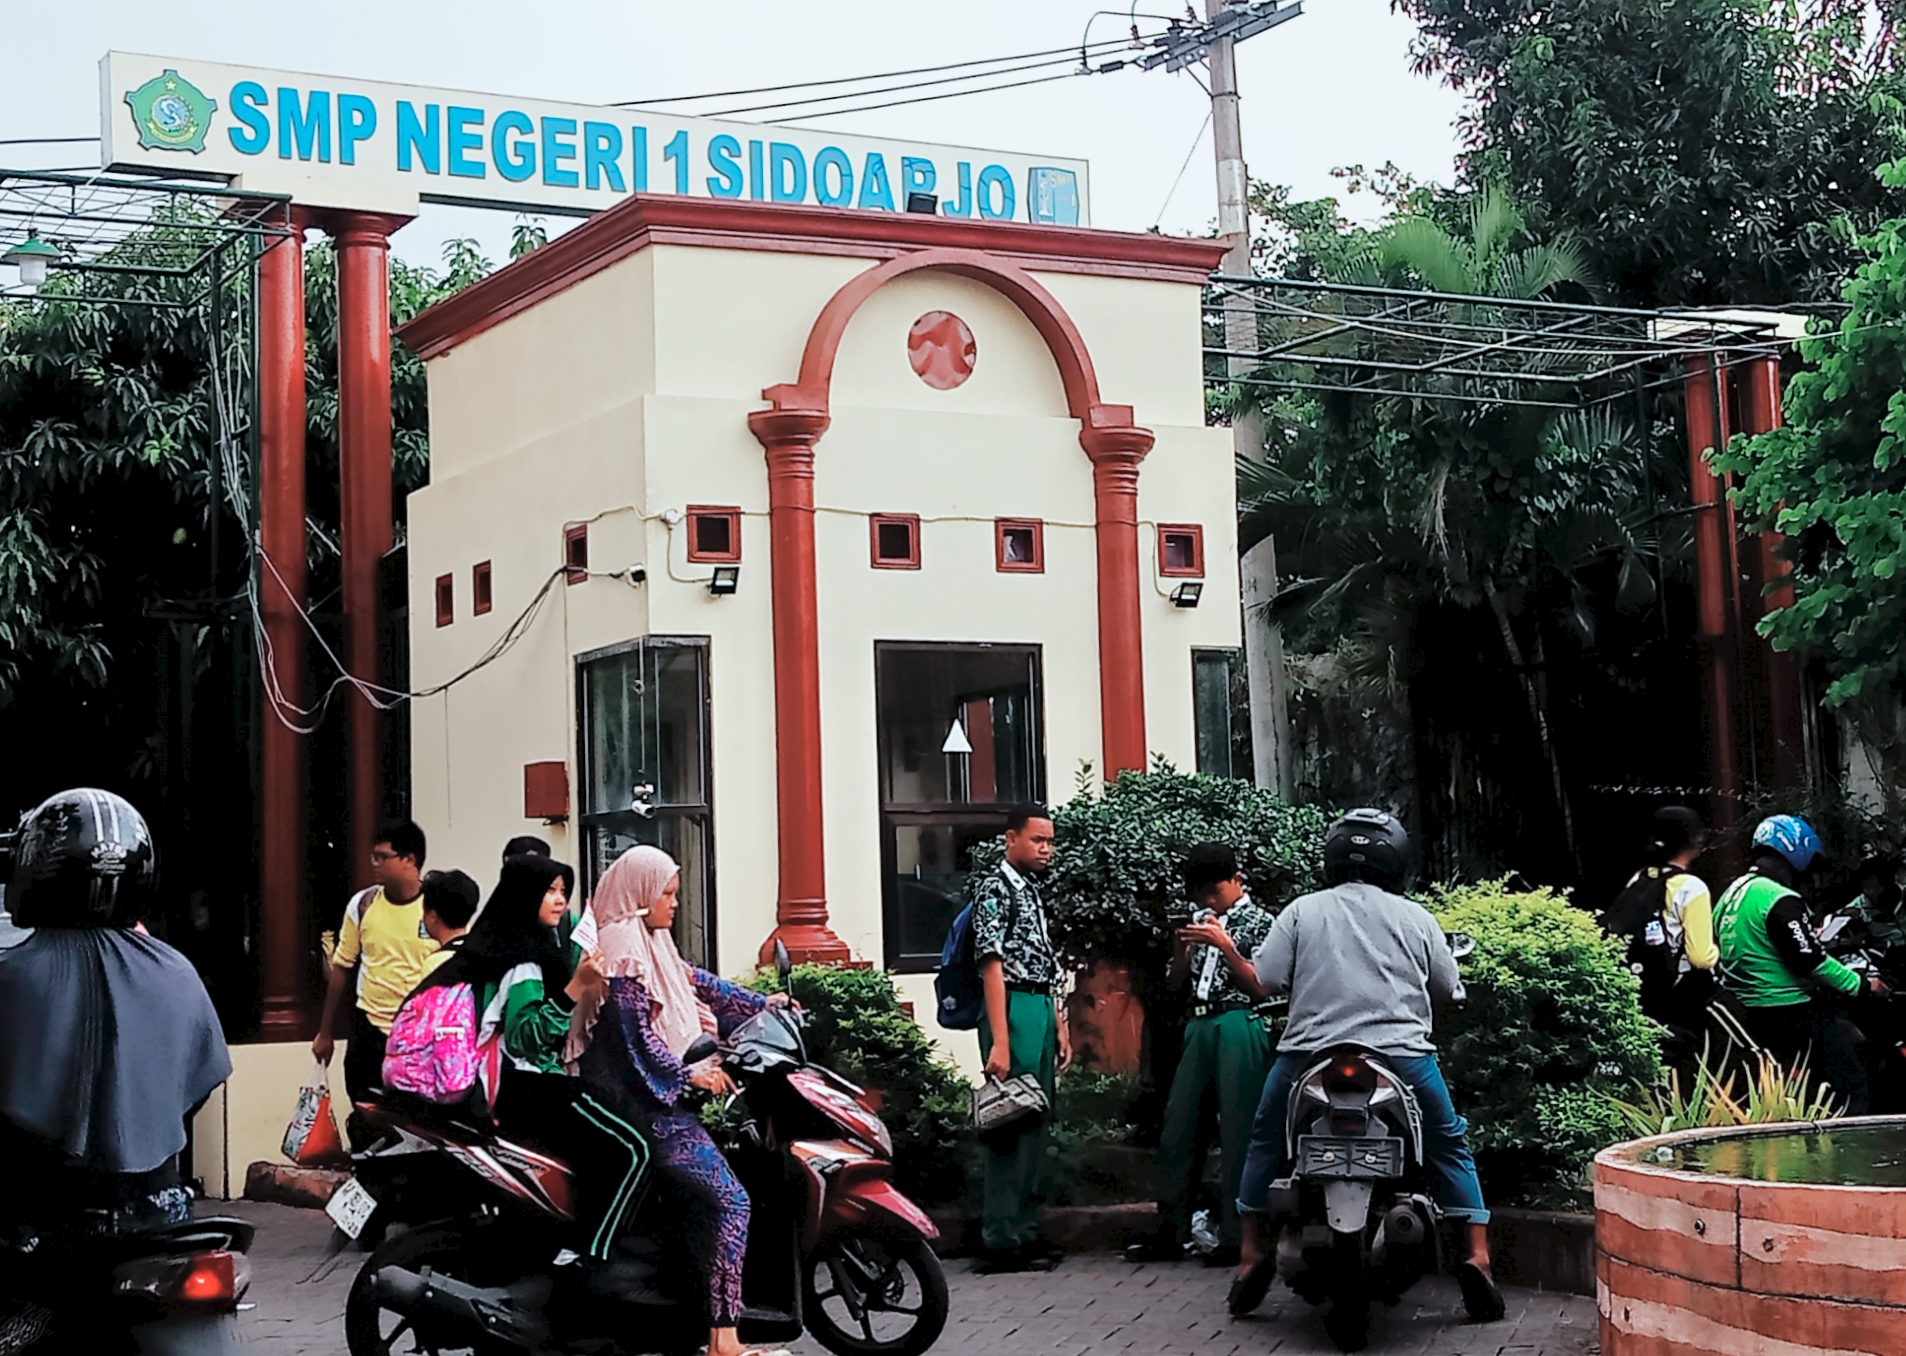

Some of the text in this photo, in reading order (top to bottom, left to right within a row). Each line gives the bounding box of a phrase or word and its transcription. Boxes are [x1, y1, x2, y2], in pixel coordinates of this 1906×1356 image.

[228, 81, 1016, 223] SMP NEGERI 1 SIDOARJO
